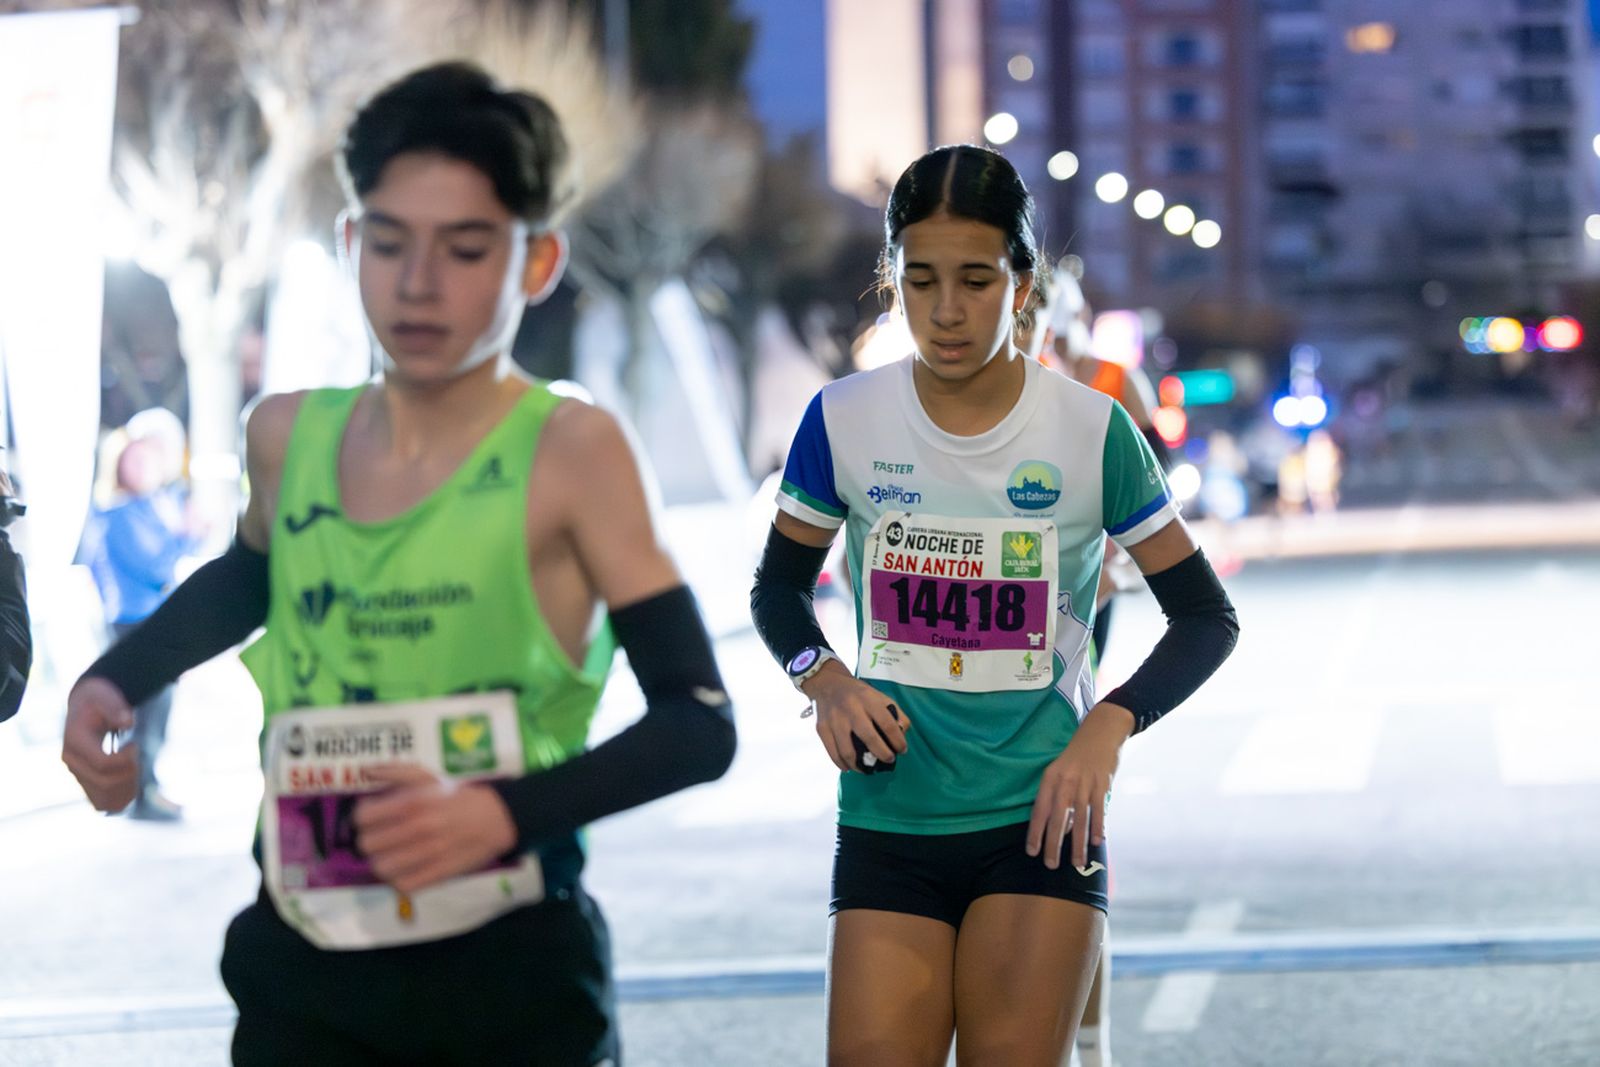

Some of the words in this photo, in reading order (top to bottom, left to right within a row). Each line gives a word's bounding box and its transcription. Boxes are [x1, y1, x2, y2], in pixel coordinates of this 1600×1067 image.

[873, 461, 914, 474] FASTER
[1012, 491, 1026, 501] Las
[1027, 491, 1057, 502] Cabezas
[886, 527, 902, 541] 43
[904, 534, 958, 554] NOCHE
[962, 539, 984, 555] DE
[883, 552, 917, 573] SAN
[921, 556, 984, 578] ANTÓN
[889, 577, 1027, 633] 14418
[931, 632, 981, 649] Cayetana
